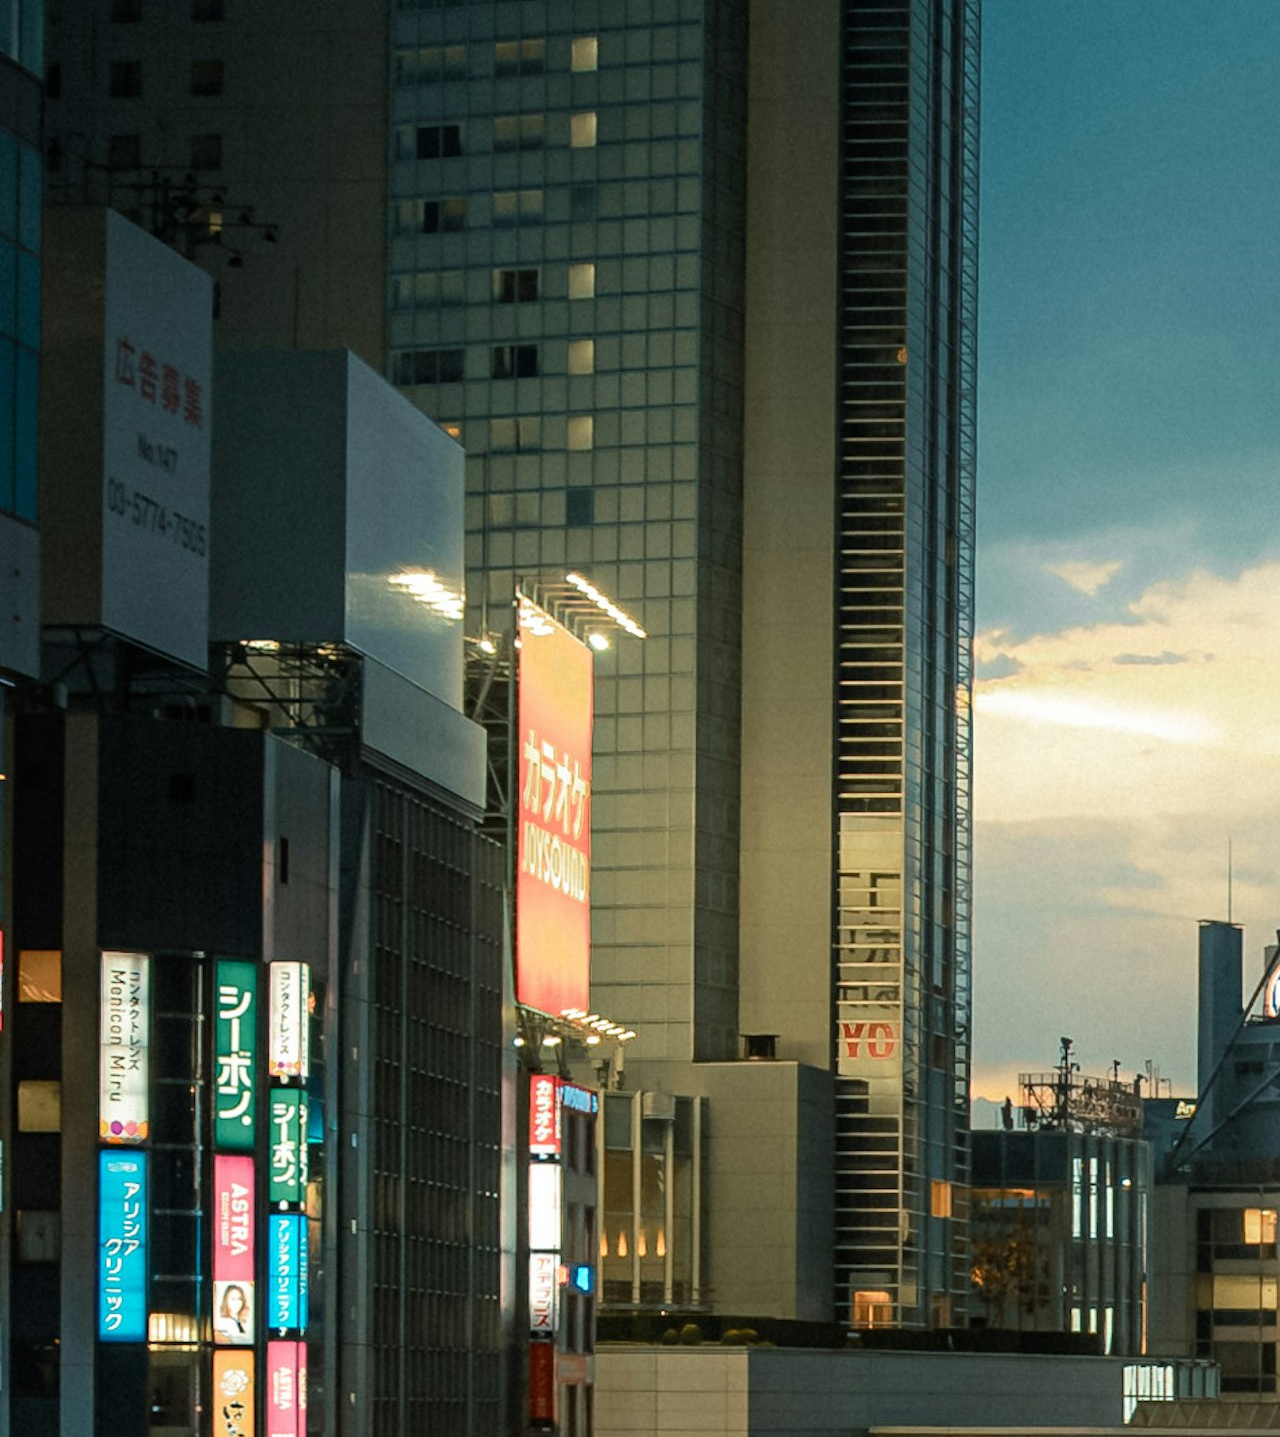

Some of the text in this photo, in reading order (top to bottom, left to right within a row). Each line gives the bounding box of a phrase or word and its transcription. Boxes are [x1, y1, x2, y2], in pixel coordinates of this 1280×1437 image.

[116, 337, 203, 430] 広告募集
[137, 432, 179, 474] No.147
[523, 729, 588, 840] カラオケ
[522, 821, 588, 903] JOYSOUND
[108, 969, 126, 1103] Menicon Miru
[128, 971, 141, 1071] コンタクトレンズ
[534, 1081, 553, 1141] カラオケ
[123, 1182, 141, 1257] アリシア
[230, 1183, 250, 1256] ASTRA
[104, 1238, 123, 1332] クリニック
[279, 1366, 292, 1411] ASTRA
